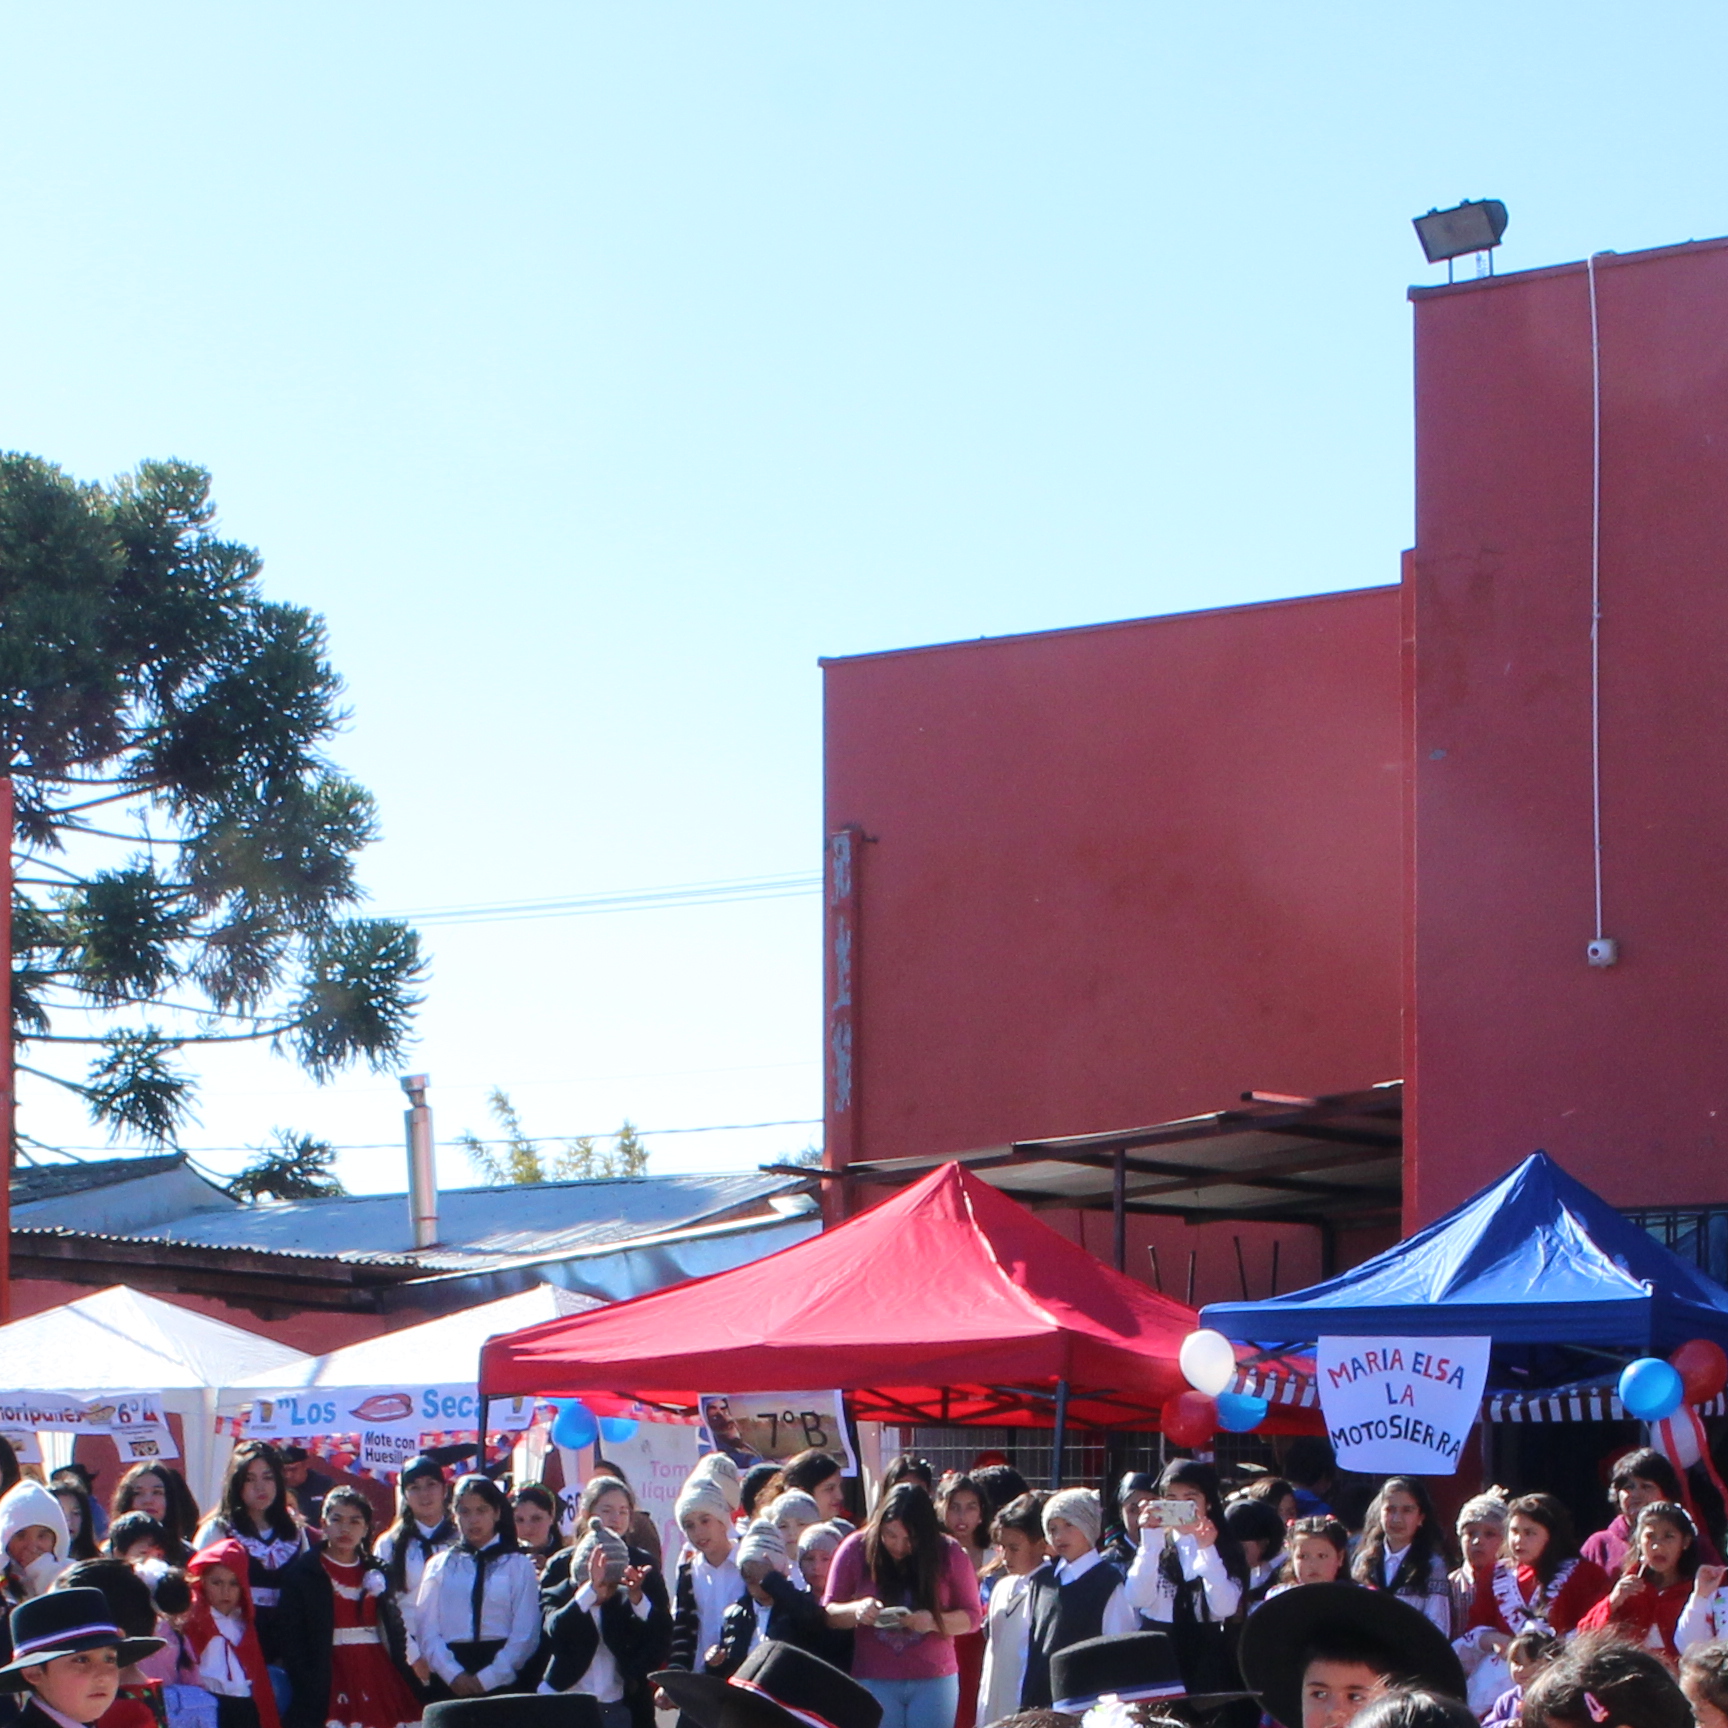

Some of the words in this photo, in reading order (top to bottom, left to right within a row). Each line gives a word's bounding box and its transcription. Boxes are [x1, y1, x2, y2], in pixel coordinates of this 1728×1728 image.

[1327, 1348, 1404, 1389] MARIA
[1412, 1351, 1465, 1390] ELSA
[1385, 1382, 1414, 1407] LA
[365, 1430, 393, 1448] Mote
[395, 1436, 416, 1449] con
[1331, 1415, 1461, 1461] MOTOSIERRA
[651, 1460, 695, 1478] Tom
